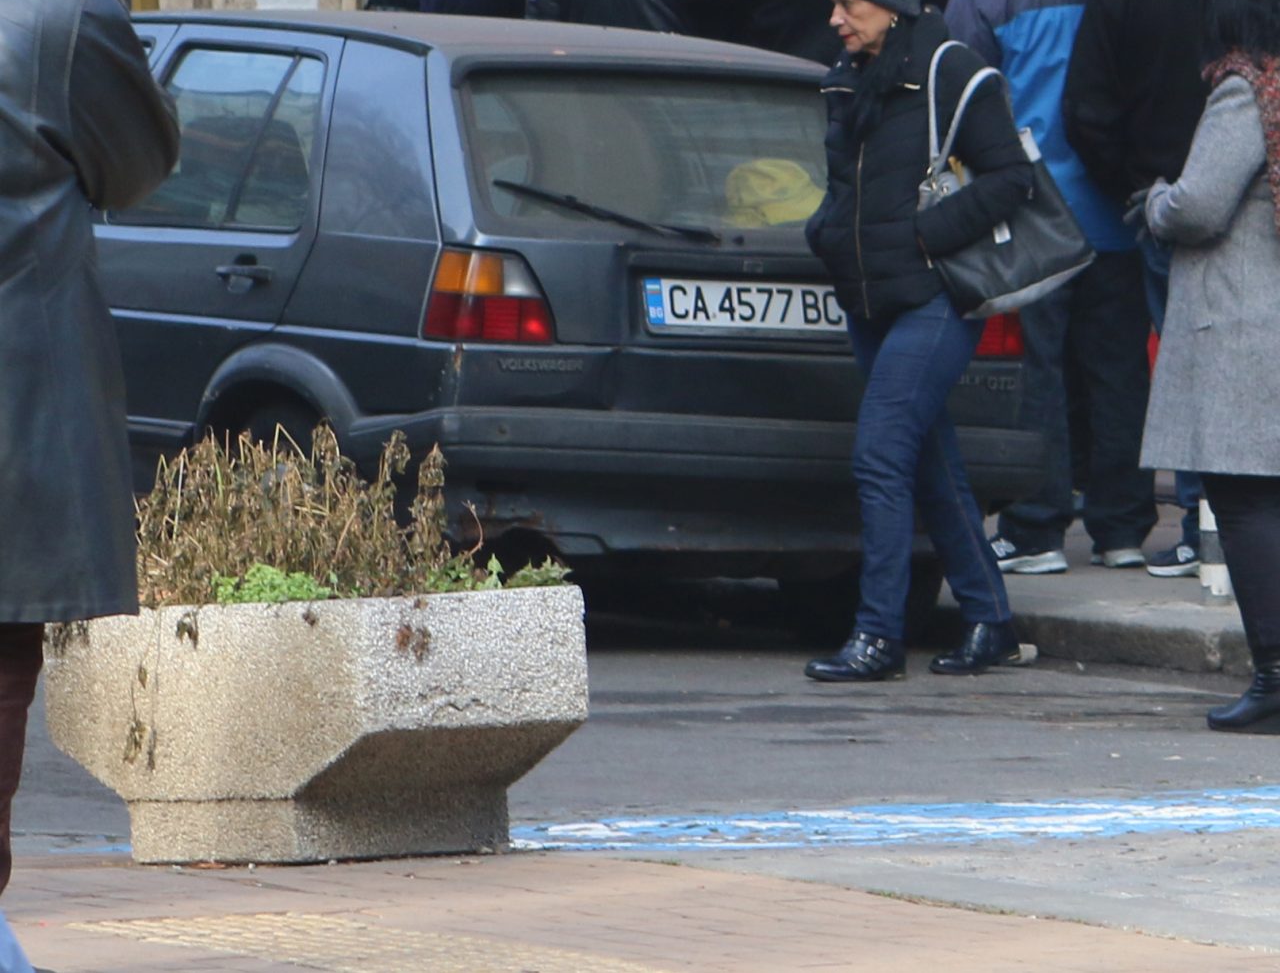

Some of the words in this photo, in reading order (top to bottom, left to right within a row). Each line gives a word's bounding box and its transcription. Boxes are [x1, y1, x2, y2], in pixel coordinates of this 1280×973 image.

[668, 284, 711, 321] CA
[718, 287, 794, 324] 4577
[801, 290, 843, 326] BC
[497, 358, 584, 372] VOLKSWAGEN
